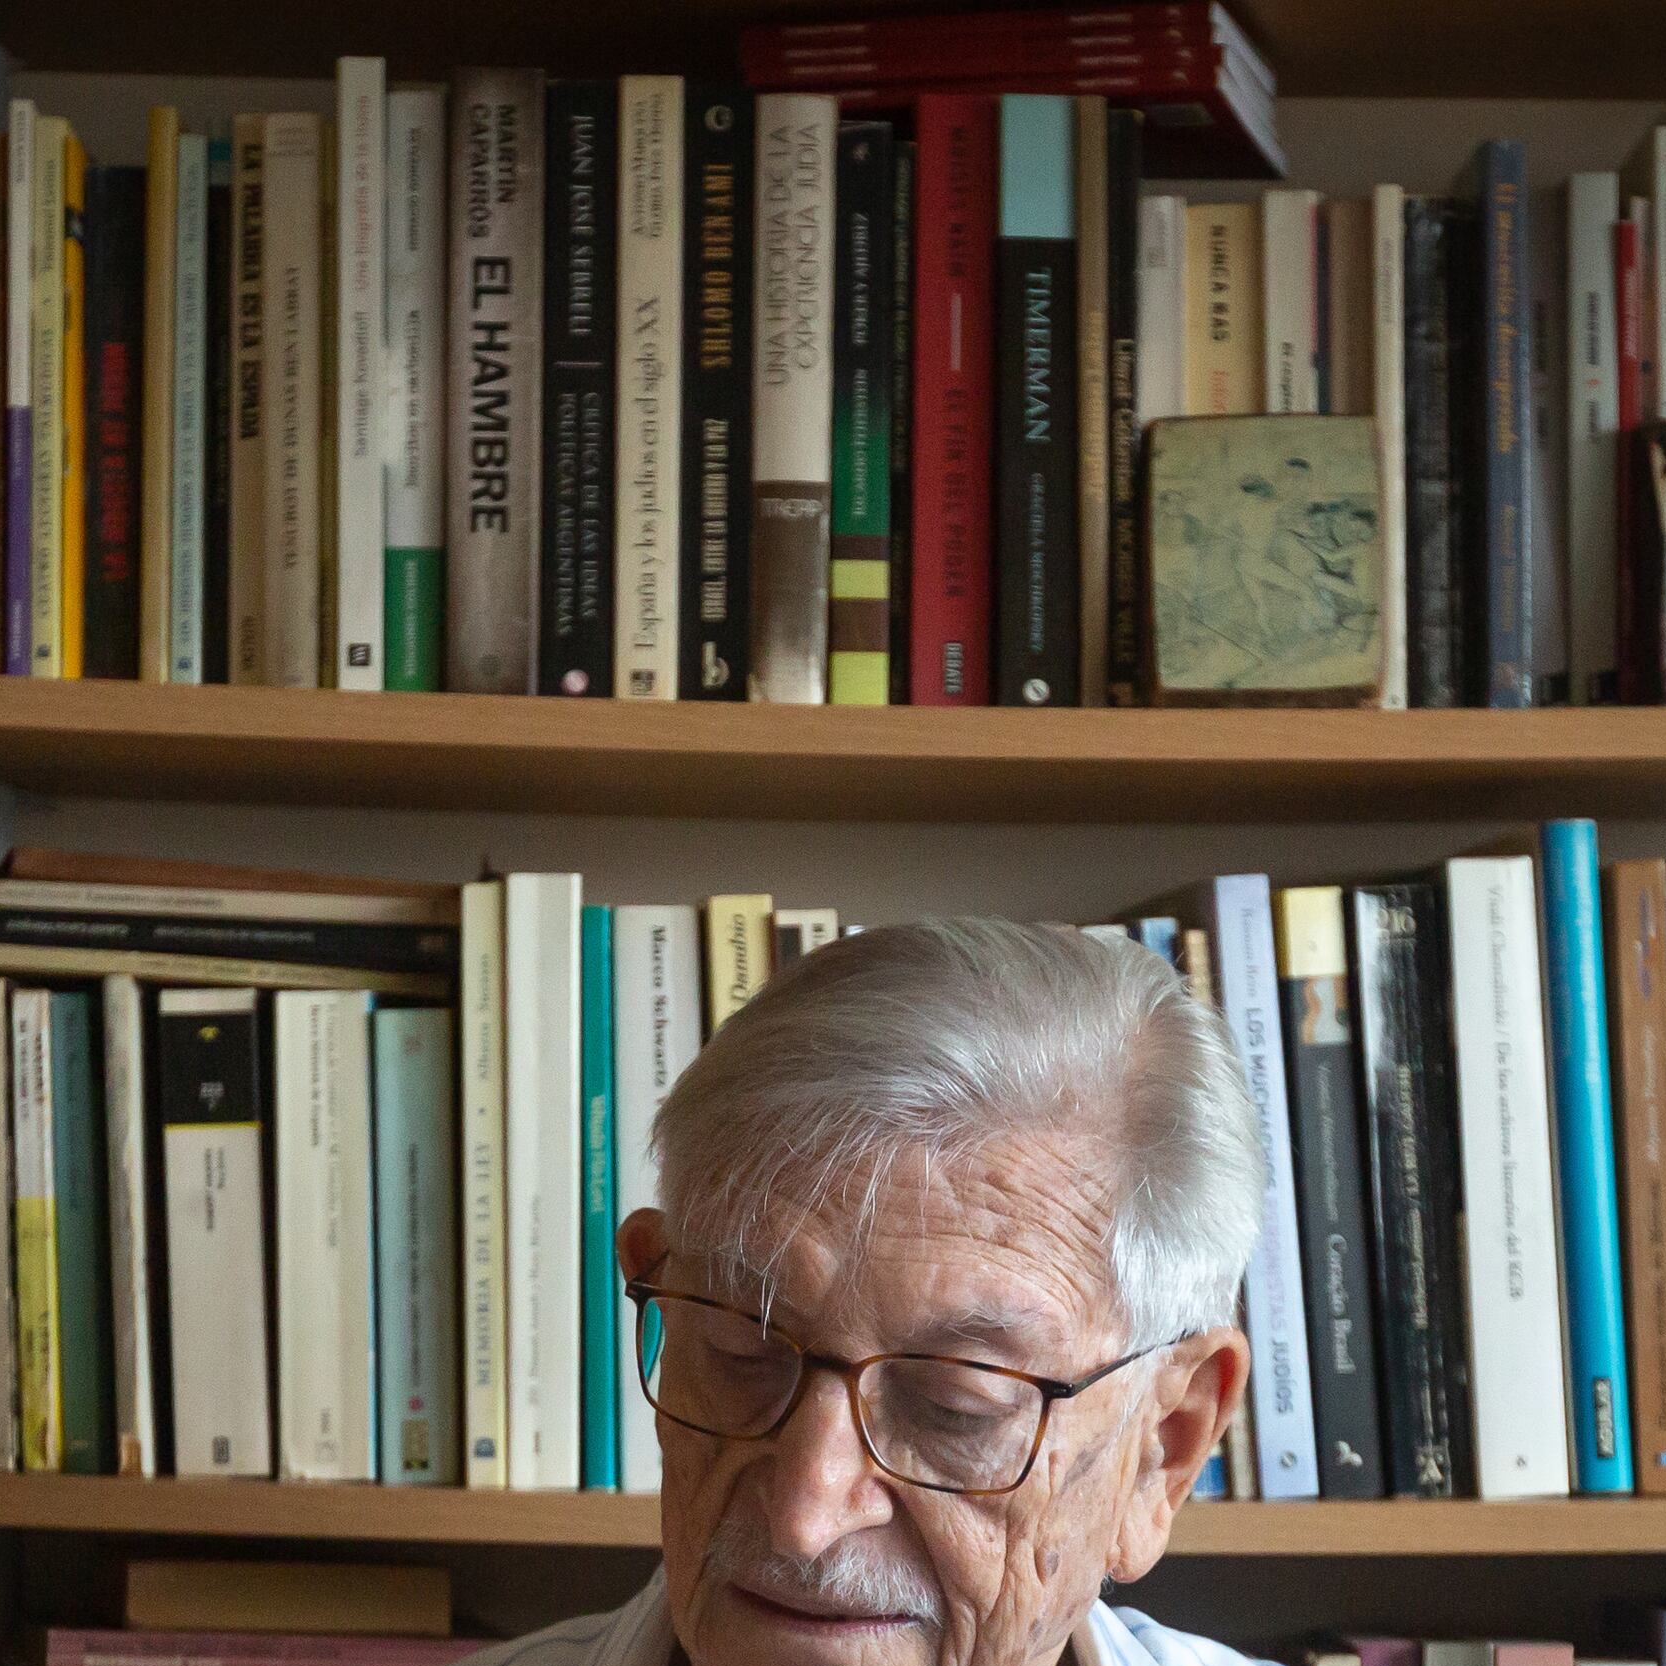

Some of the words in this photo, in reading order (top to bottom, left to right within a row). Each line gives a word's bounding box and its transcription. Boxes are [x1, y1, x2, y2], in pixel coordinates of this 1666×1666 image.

[240, 142, 261, 169] LA
[568, 115, 595, 175] JUAN
[470, 257, 512, 309] EL
[767, 208, 792, 322] HISTORIA
[1210, 225, 1231, 292] NUNCA
[632, 296, 662, 335] XX
[703, 274, 730, 369] SHLOMO
[767, 330, 792, 387] UNA
[1023, 268, 1051, 442] TIMERMAN
[350, 392, 371, 458] Santiago
[470, 321, 512, 533] HAMBRE
[632, 577, 662, 650] España
[651, 924, 672, 987] Marco
[651, 994, 672, 1088] Schwartz
[1244, 1007, 1268, 1048] LOS
[474, 1142, 493, 1179] LEY
[474, 1194, 493, 1221] LA
[474, 1233, 493, 1264] DE
[474, 1276, 493, 1386] MEMORIA
